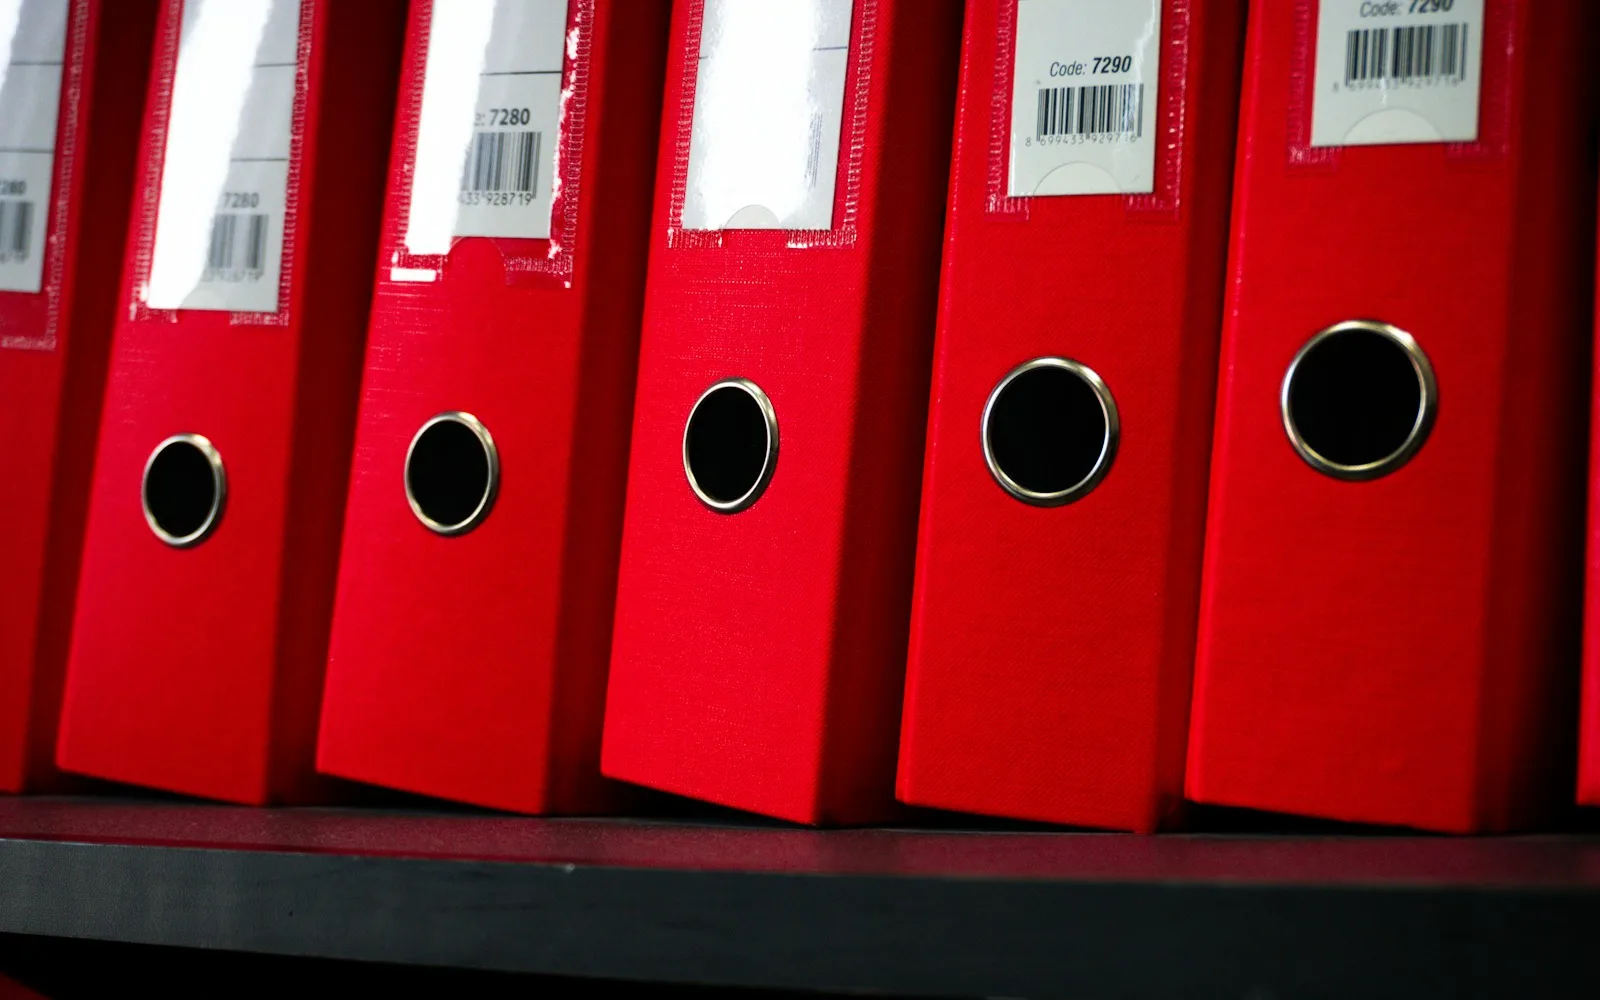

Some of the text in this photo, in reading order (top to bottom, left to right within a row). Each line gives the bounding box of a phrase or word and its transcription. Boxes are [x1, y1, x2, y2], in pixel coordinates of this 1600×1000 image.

[1360, 0, 1401, 17] Code:
[1049, 55, 1132, 77] Code: 7290
[489, 107, 531, 126] 7280
[1025, 137, 1032, 147] 8
[1040, 133, 1085, 147] 699433
